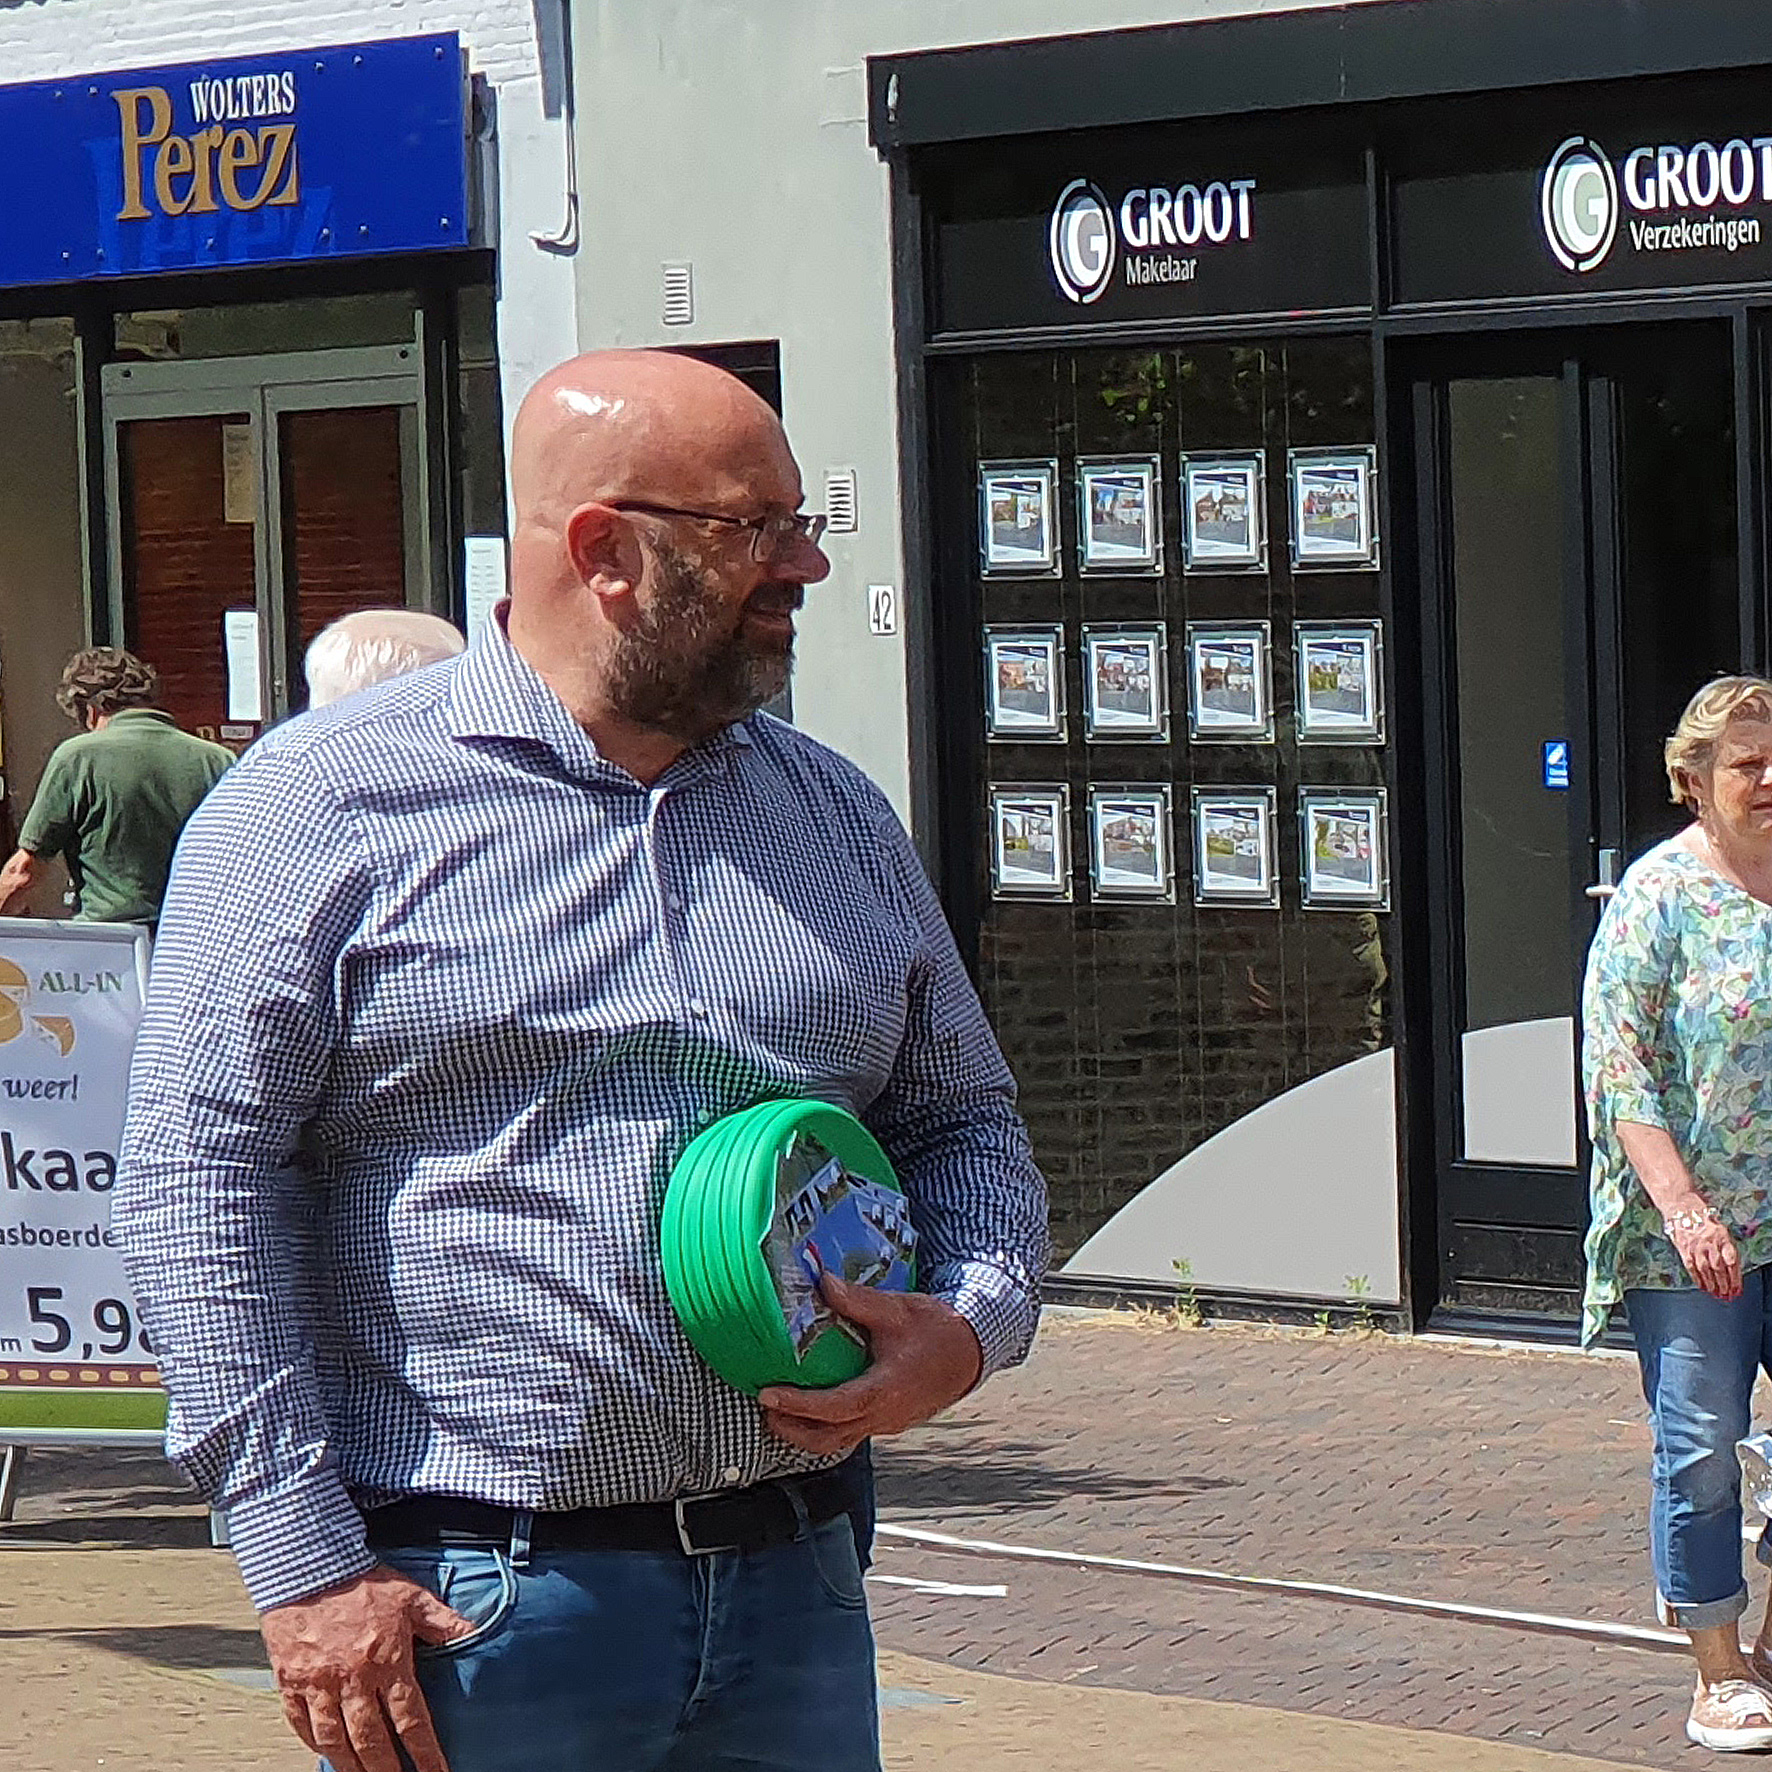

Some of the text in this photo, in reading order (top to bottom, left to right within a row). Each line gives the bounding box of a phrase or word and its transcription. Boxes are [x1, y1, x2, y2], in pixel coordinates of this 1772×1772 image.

[190, 71, 295, 123] WOLTERS
[110, 86, 299, 221] Perez
[1121, 180, 1256, 248] GROOT
[1629, 215, 1761, 252] Verzekeringen
[1125, 254, 1198, 286] Makelaar
[872, 590, 892, 631] 42
[39, 971, 122, 994] ALL-IN
[2, 1074, 78, 1101] weer!
